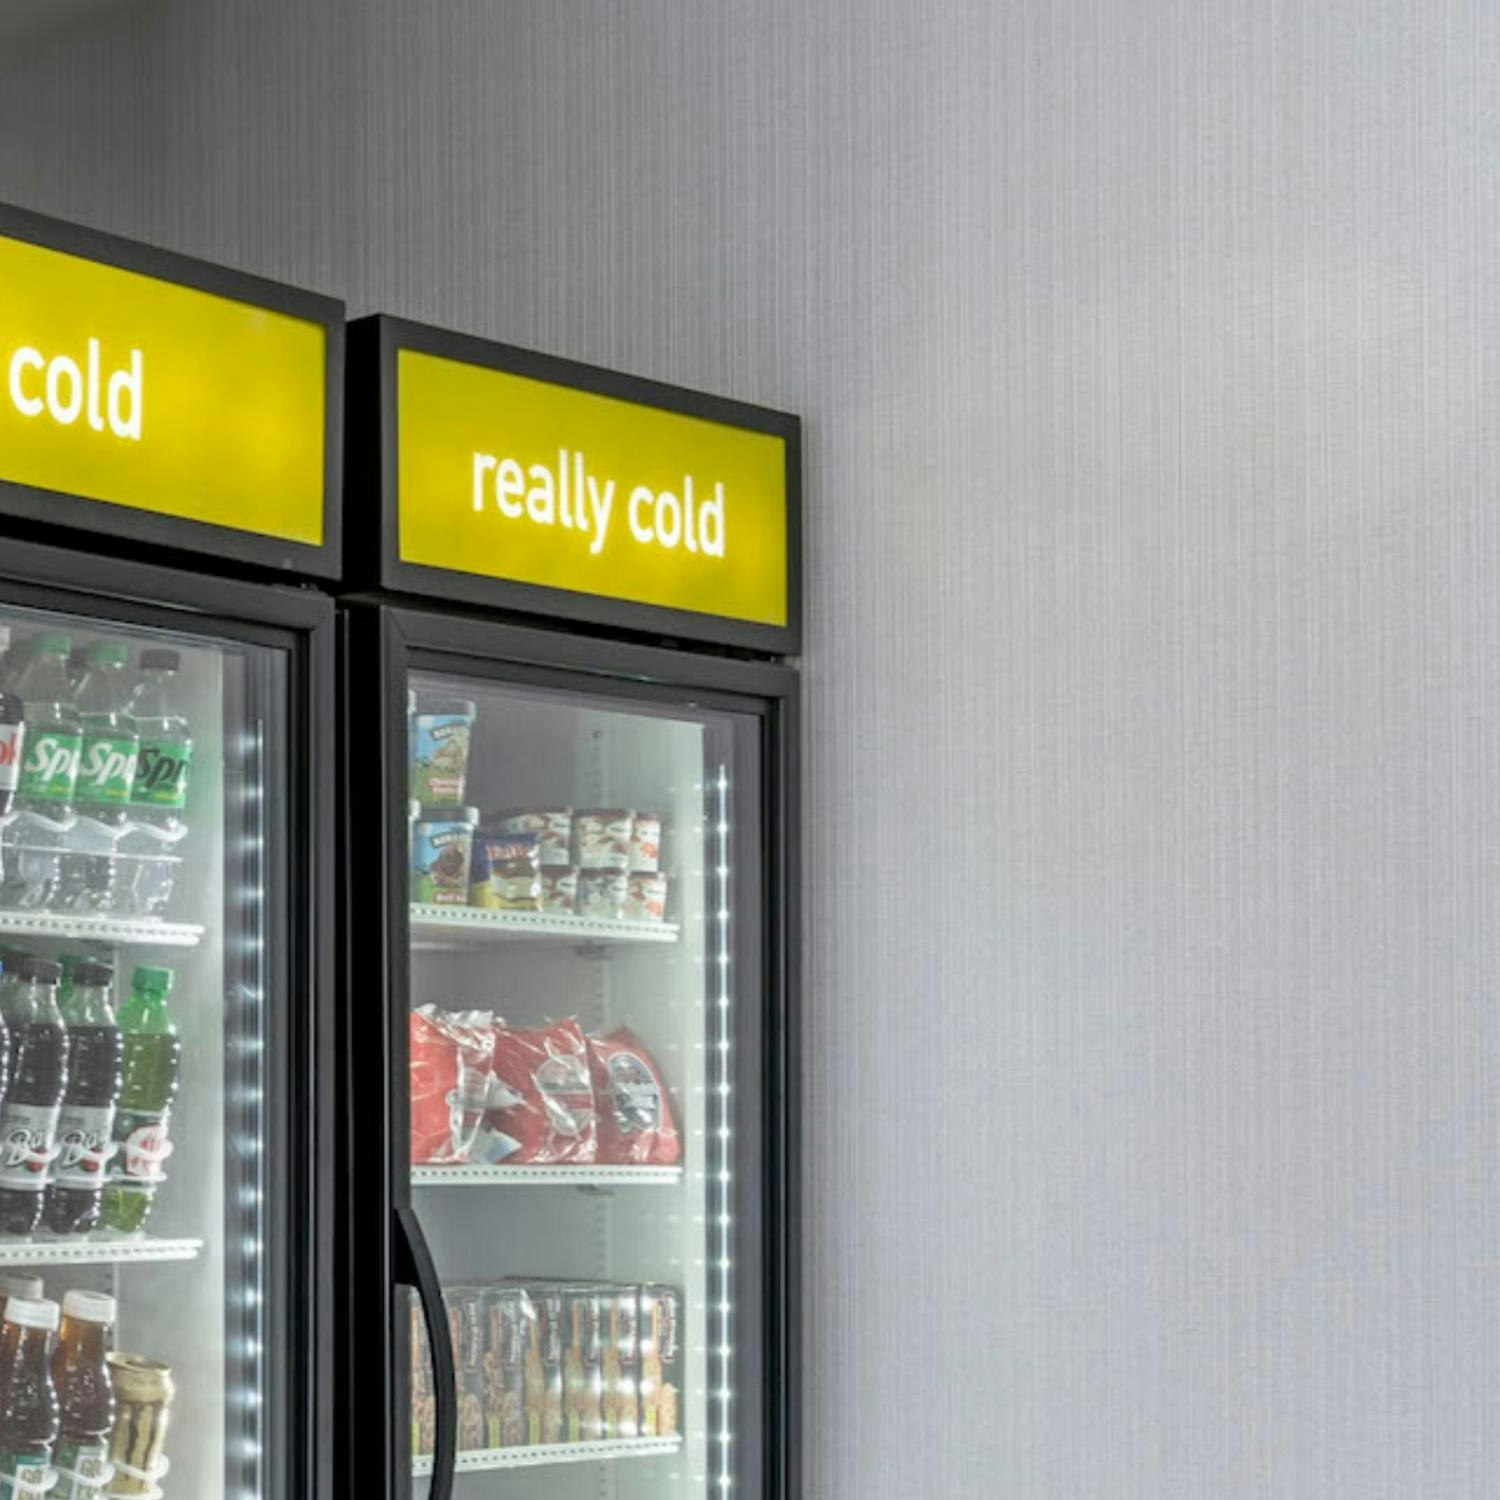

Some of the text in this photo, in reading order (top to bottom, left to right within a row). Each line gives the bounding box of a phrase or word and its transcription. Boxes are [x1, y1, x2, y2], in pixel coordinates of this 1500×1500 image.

[9, 339, 142, 441] cold
[473, 449, 726, 558] really cold
